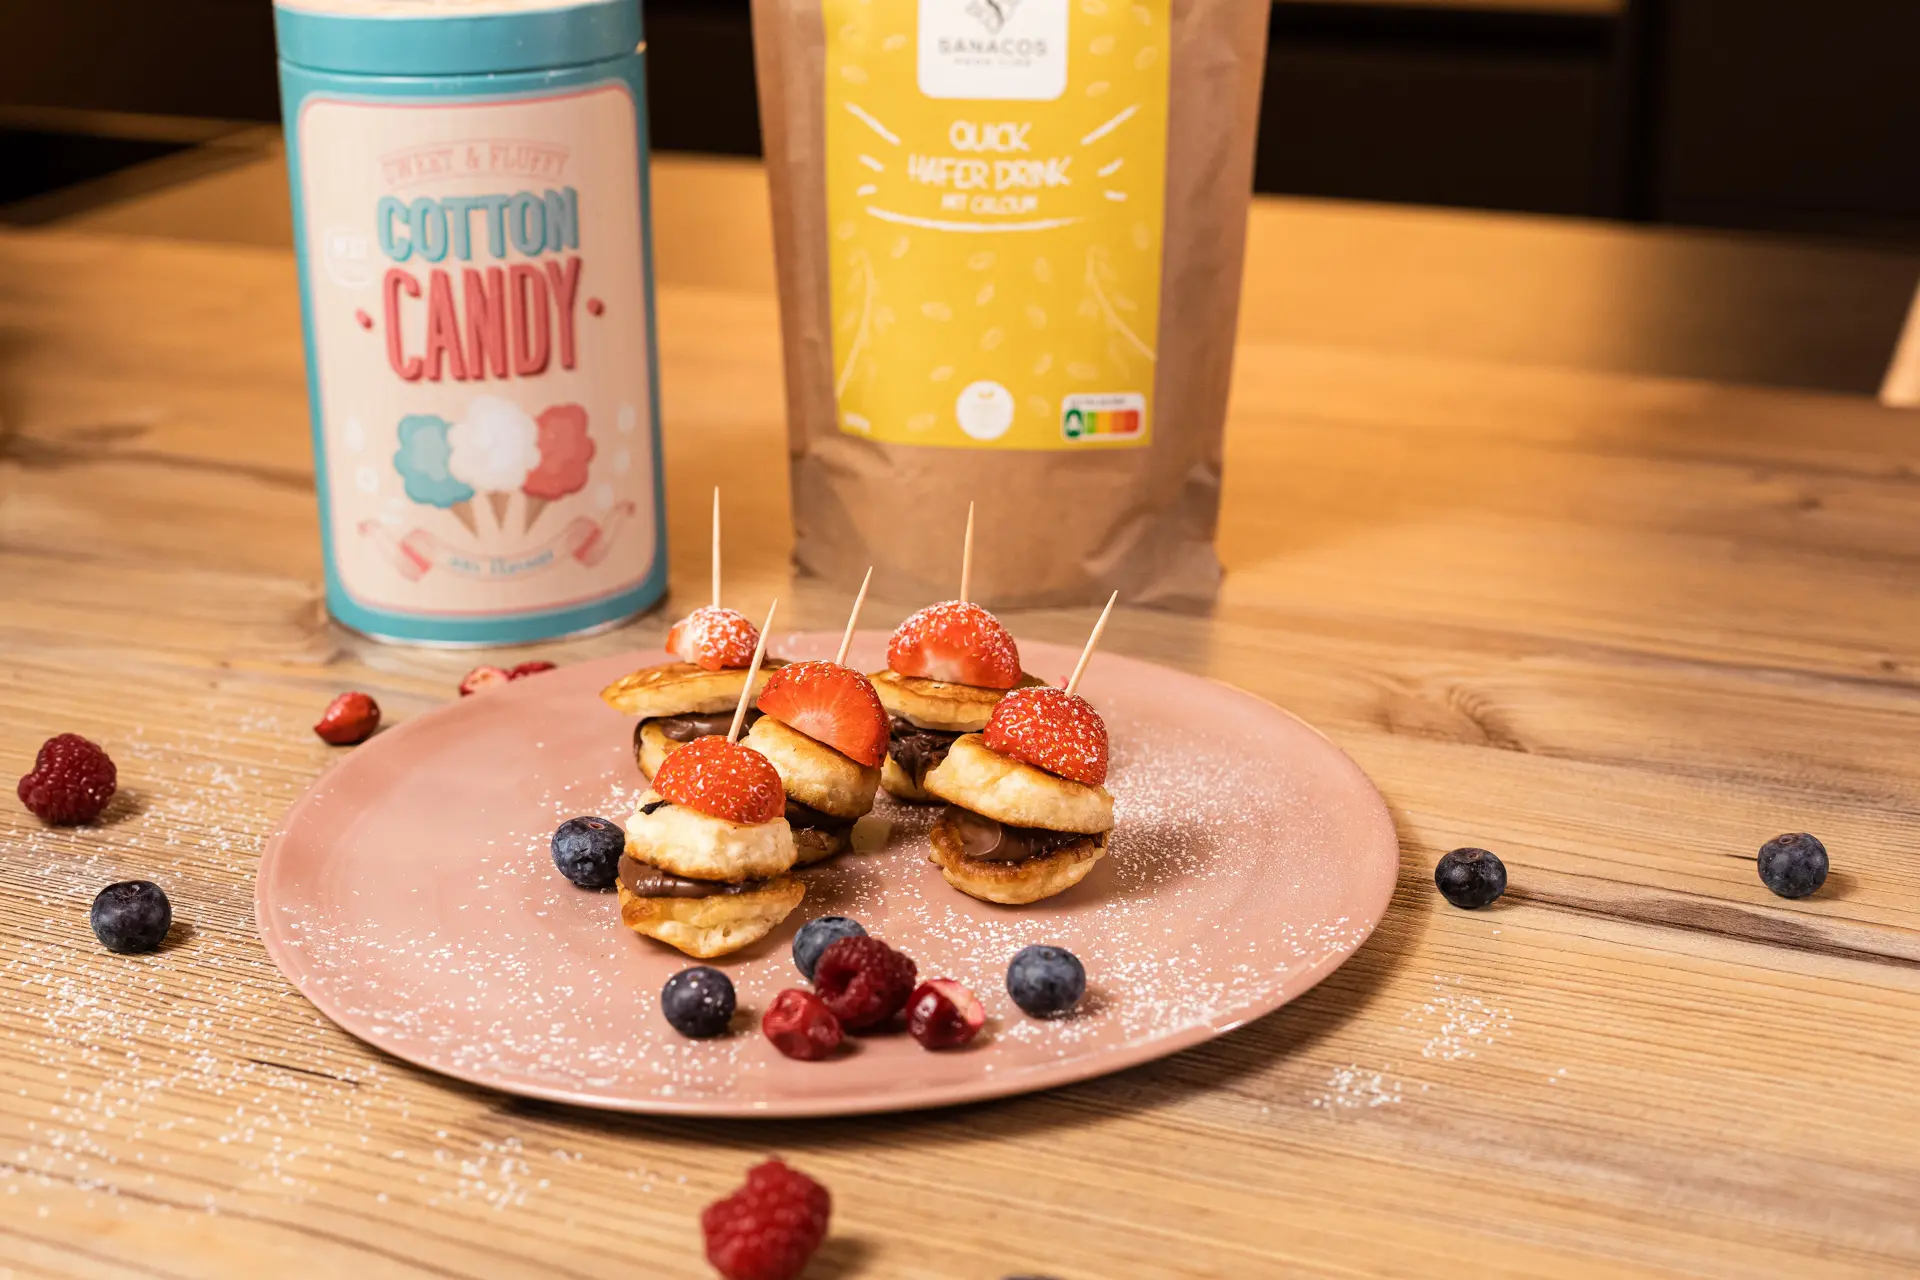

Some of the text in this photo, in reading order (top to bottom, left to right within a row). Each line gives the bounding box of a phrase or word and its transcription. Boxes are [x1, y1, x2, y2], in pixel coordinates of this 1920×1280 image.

[949, 120, 1032, 152] QUICK
[465, 146, 481, 171] &
[489, 144, 570, 176] FLUFFY
[907, 153, 1073, 190] HAFER DRINK
[377, 186, 580, 263] COTTON
[383, 256, 582, 383] CANDY
